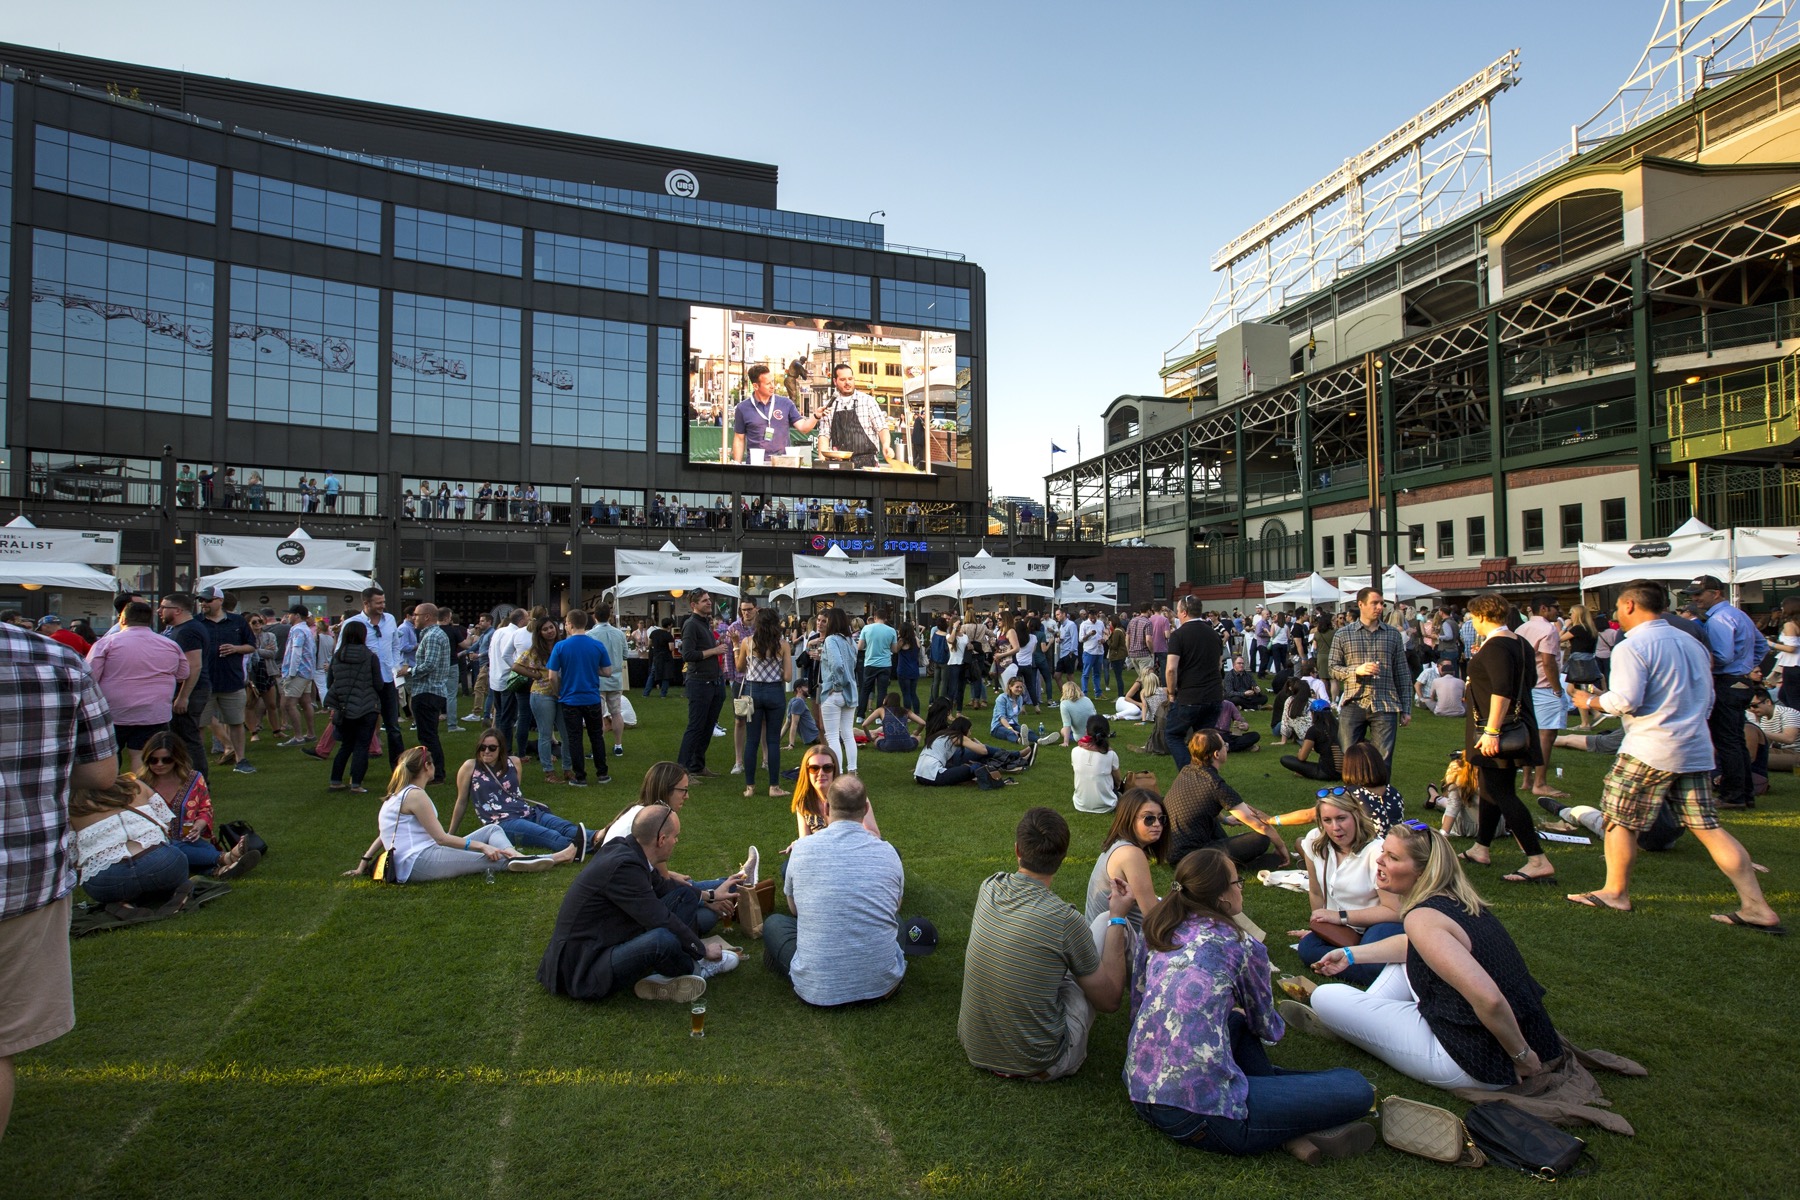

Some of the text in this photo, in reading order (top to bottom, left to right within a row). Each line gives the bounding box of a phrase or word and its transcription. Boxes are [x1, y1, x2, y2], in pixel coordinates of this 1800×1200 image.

[828, 540, 928, 552] CUBS STORE
[1487, 569, 1546, 585] DRINKS
